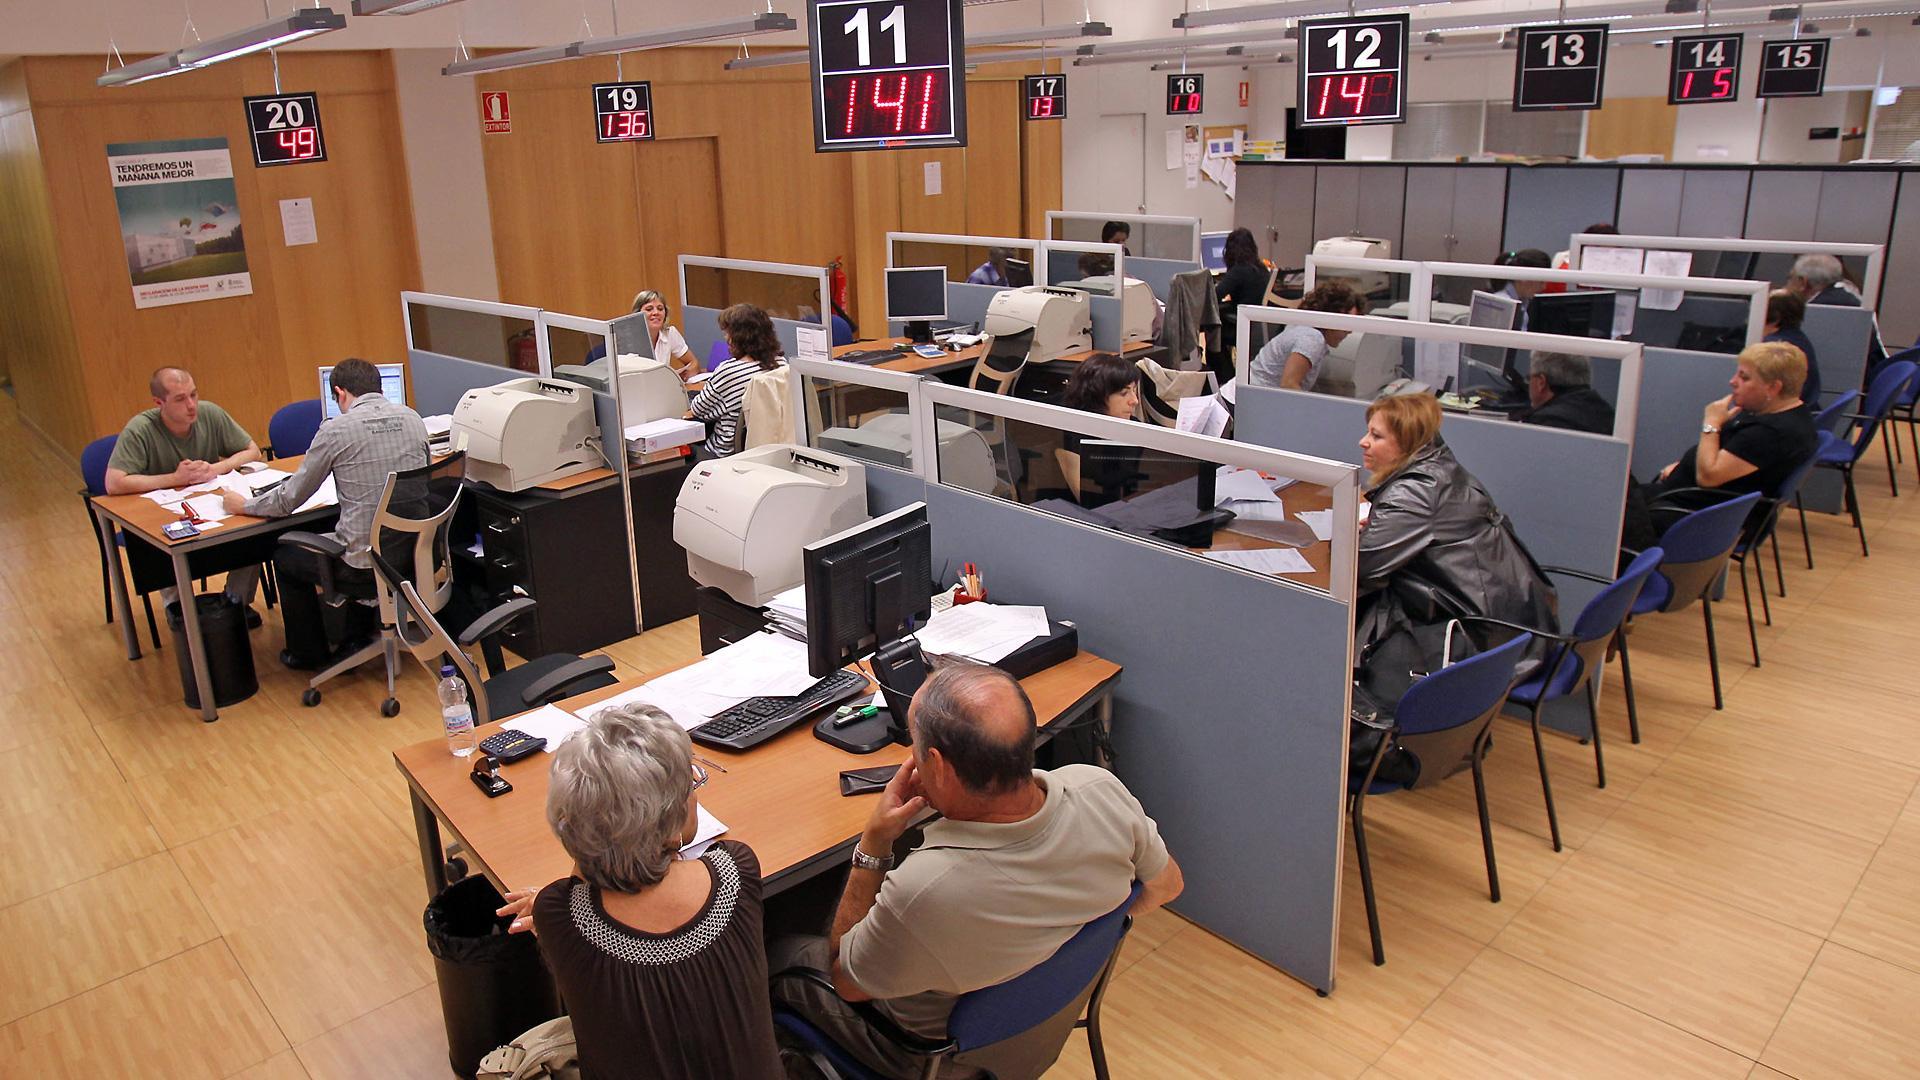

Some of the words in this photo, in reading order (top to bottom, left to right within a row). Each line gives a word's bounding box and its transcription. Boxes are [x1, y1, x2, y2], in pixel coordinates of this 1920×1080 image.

[844, 5, 907, 66] 11
[1327, 28, 1381, 69] 12
[1541, 34, 1585, 66] 13
[1690, 41, 1725, 68] 14
[1778, 45, 1812, 68] 15
[1036, 79, 1057, 96] 17
[1177, 78, 1196, 94] 16
[1319, 76, 1367, 115] 14
[607, 88, 638, 111] 19
[846, 75, 933, 133] 141
[1033, 97, 1053, 116] 13
[265, 101, 304, 129] 20
[607, 112, 646, 137] 136
[279, 128, 314, 157] 49
[116, 161, 178, 174] TENDREMOS
[179, 160, 193, 169] UN
[162, 169, 194, 179] MEJOR
